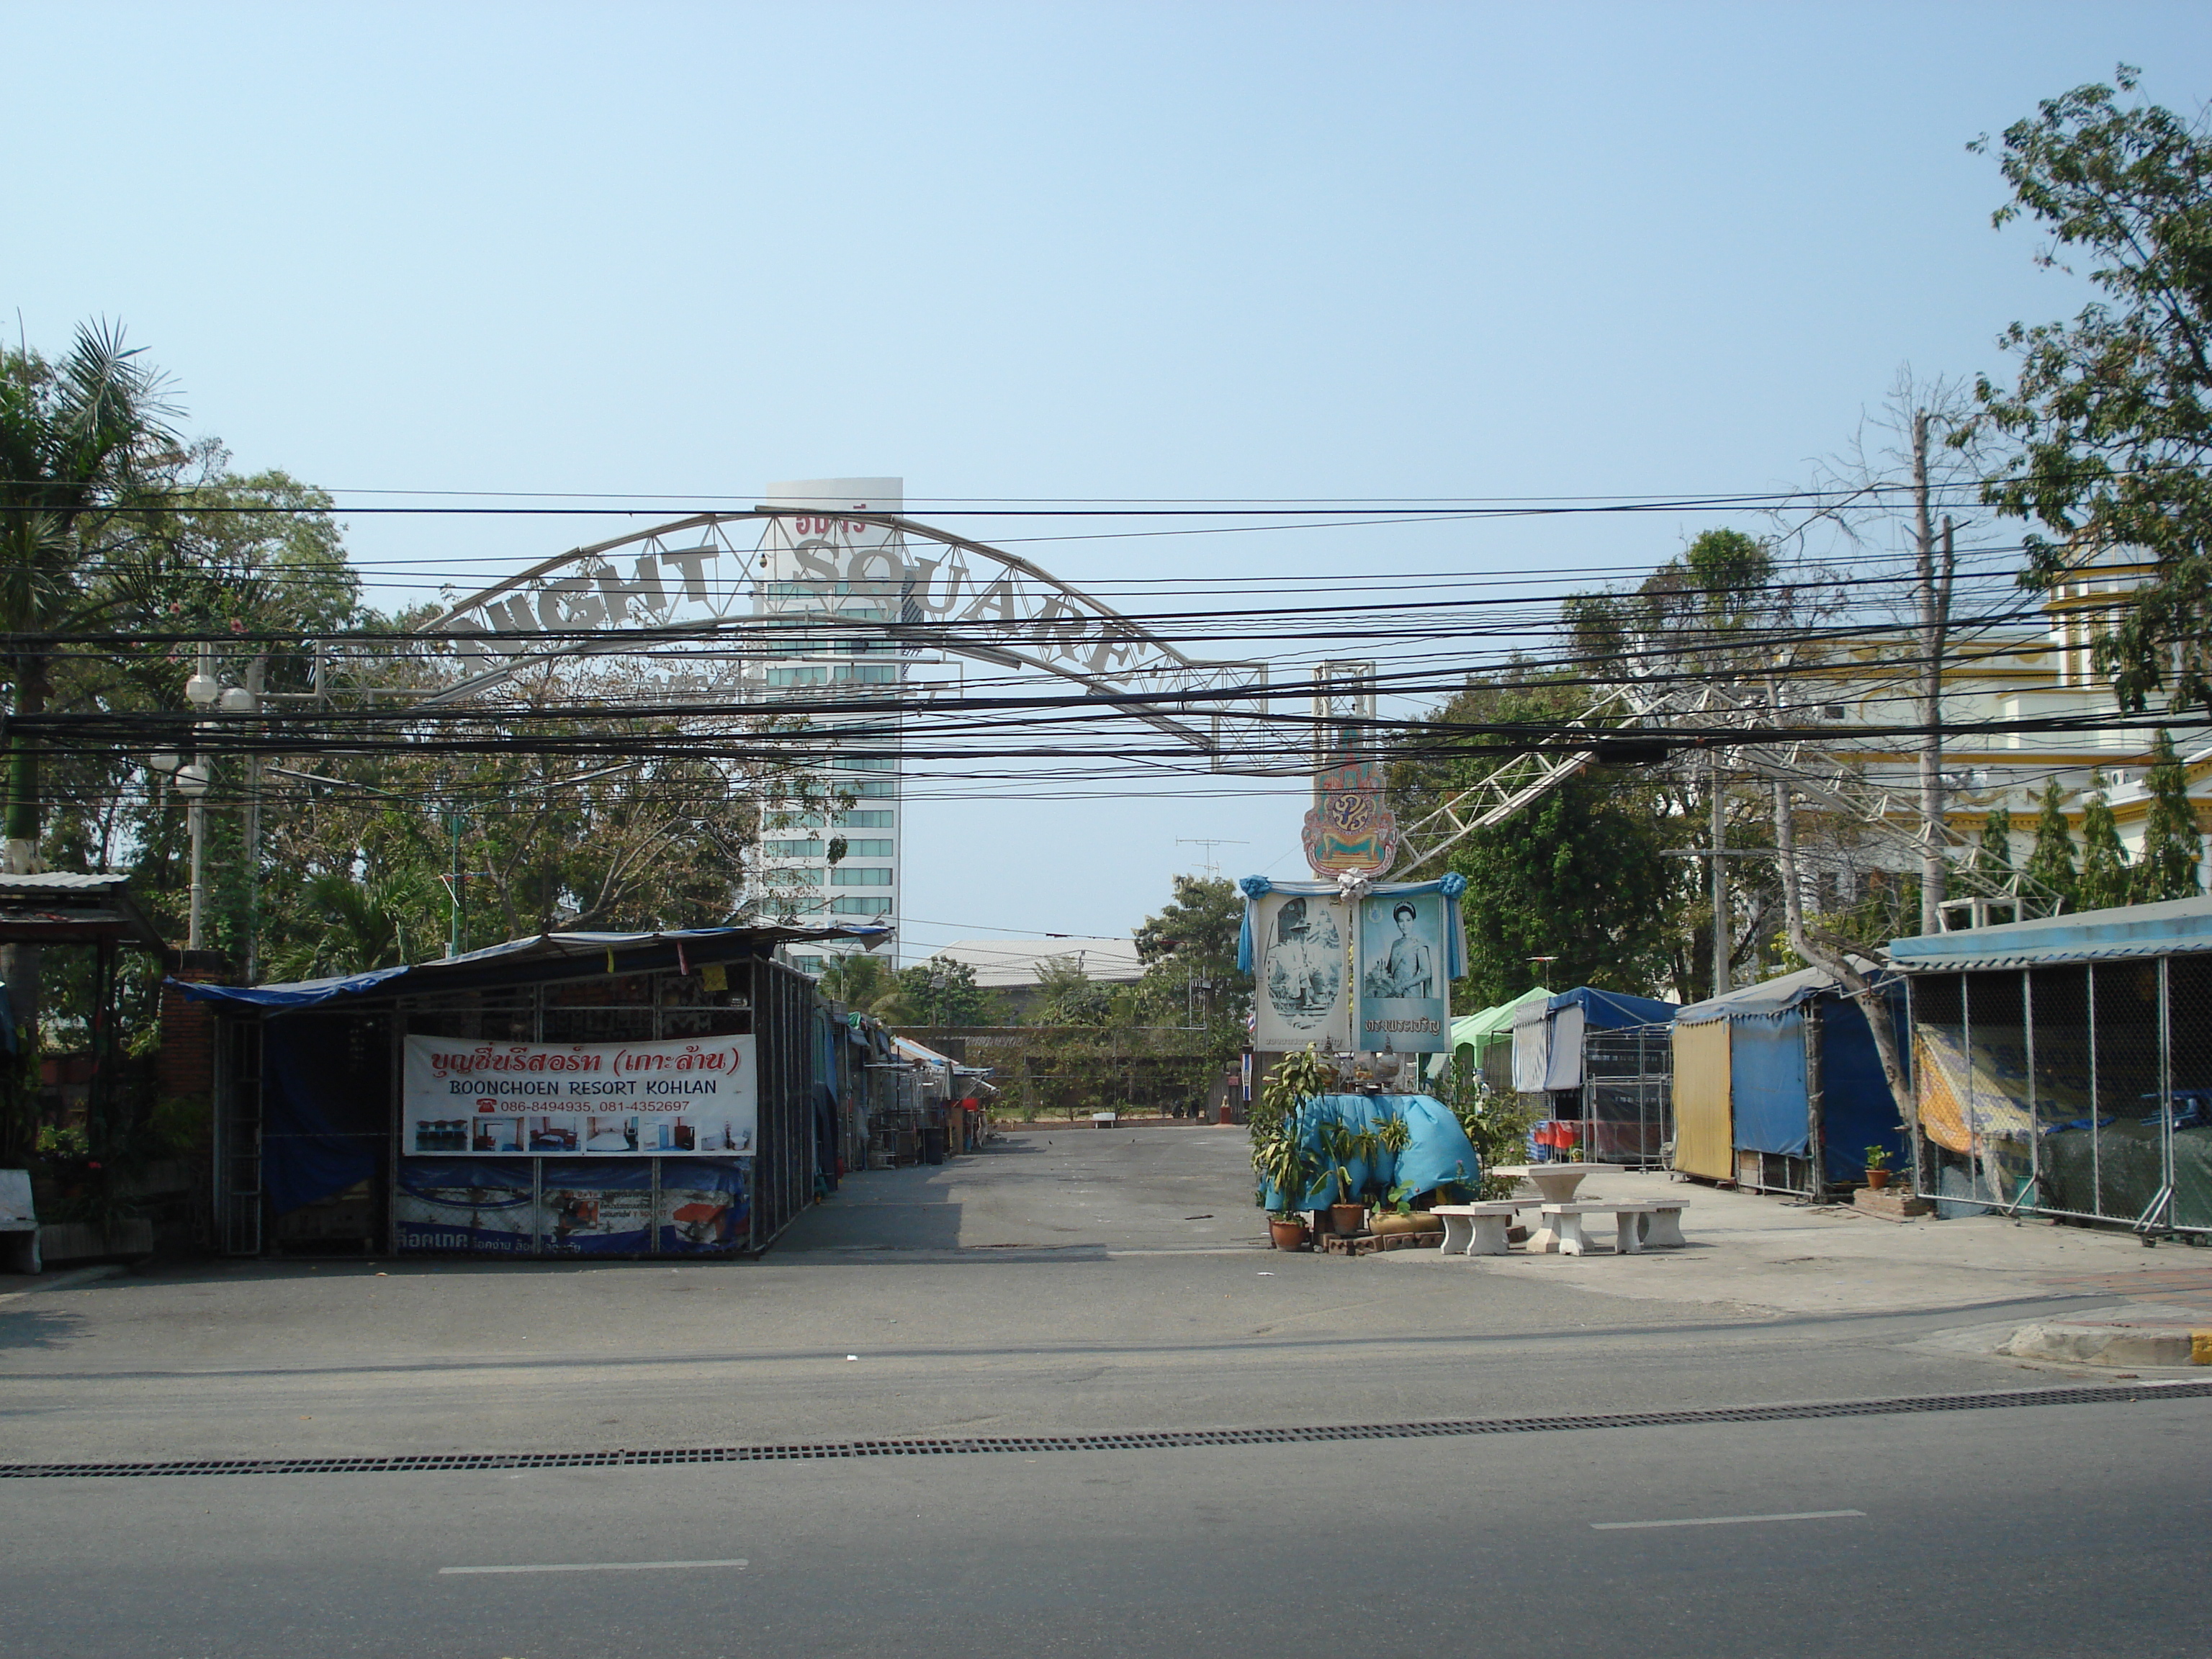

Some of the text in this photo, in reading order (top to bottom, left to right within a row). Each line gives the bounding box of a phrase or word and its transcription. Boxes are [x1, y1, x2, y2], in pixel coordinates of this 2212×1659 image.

[446, 539, 1146, 686] NIGHT SQUARE
[431, 1041, 741, 1078] บุญชื่นรีสอร์ท (เกาะล้าน)
[449, 1080, 717, 1095] BOONCHOEN RESORT KOHLAN
[500, 1101, 690, 1113] 086-8494935, 081-4352697
